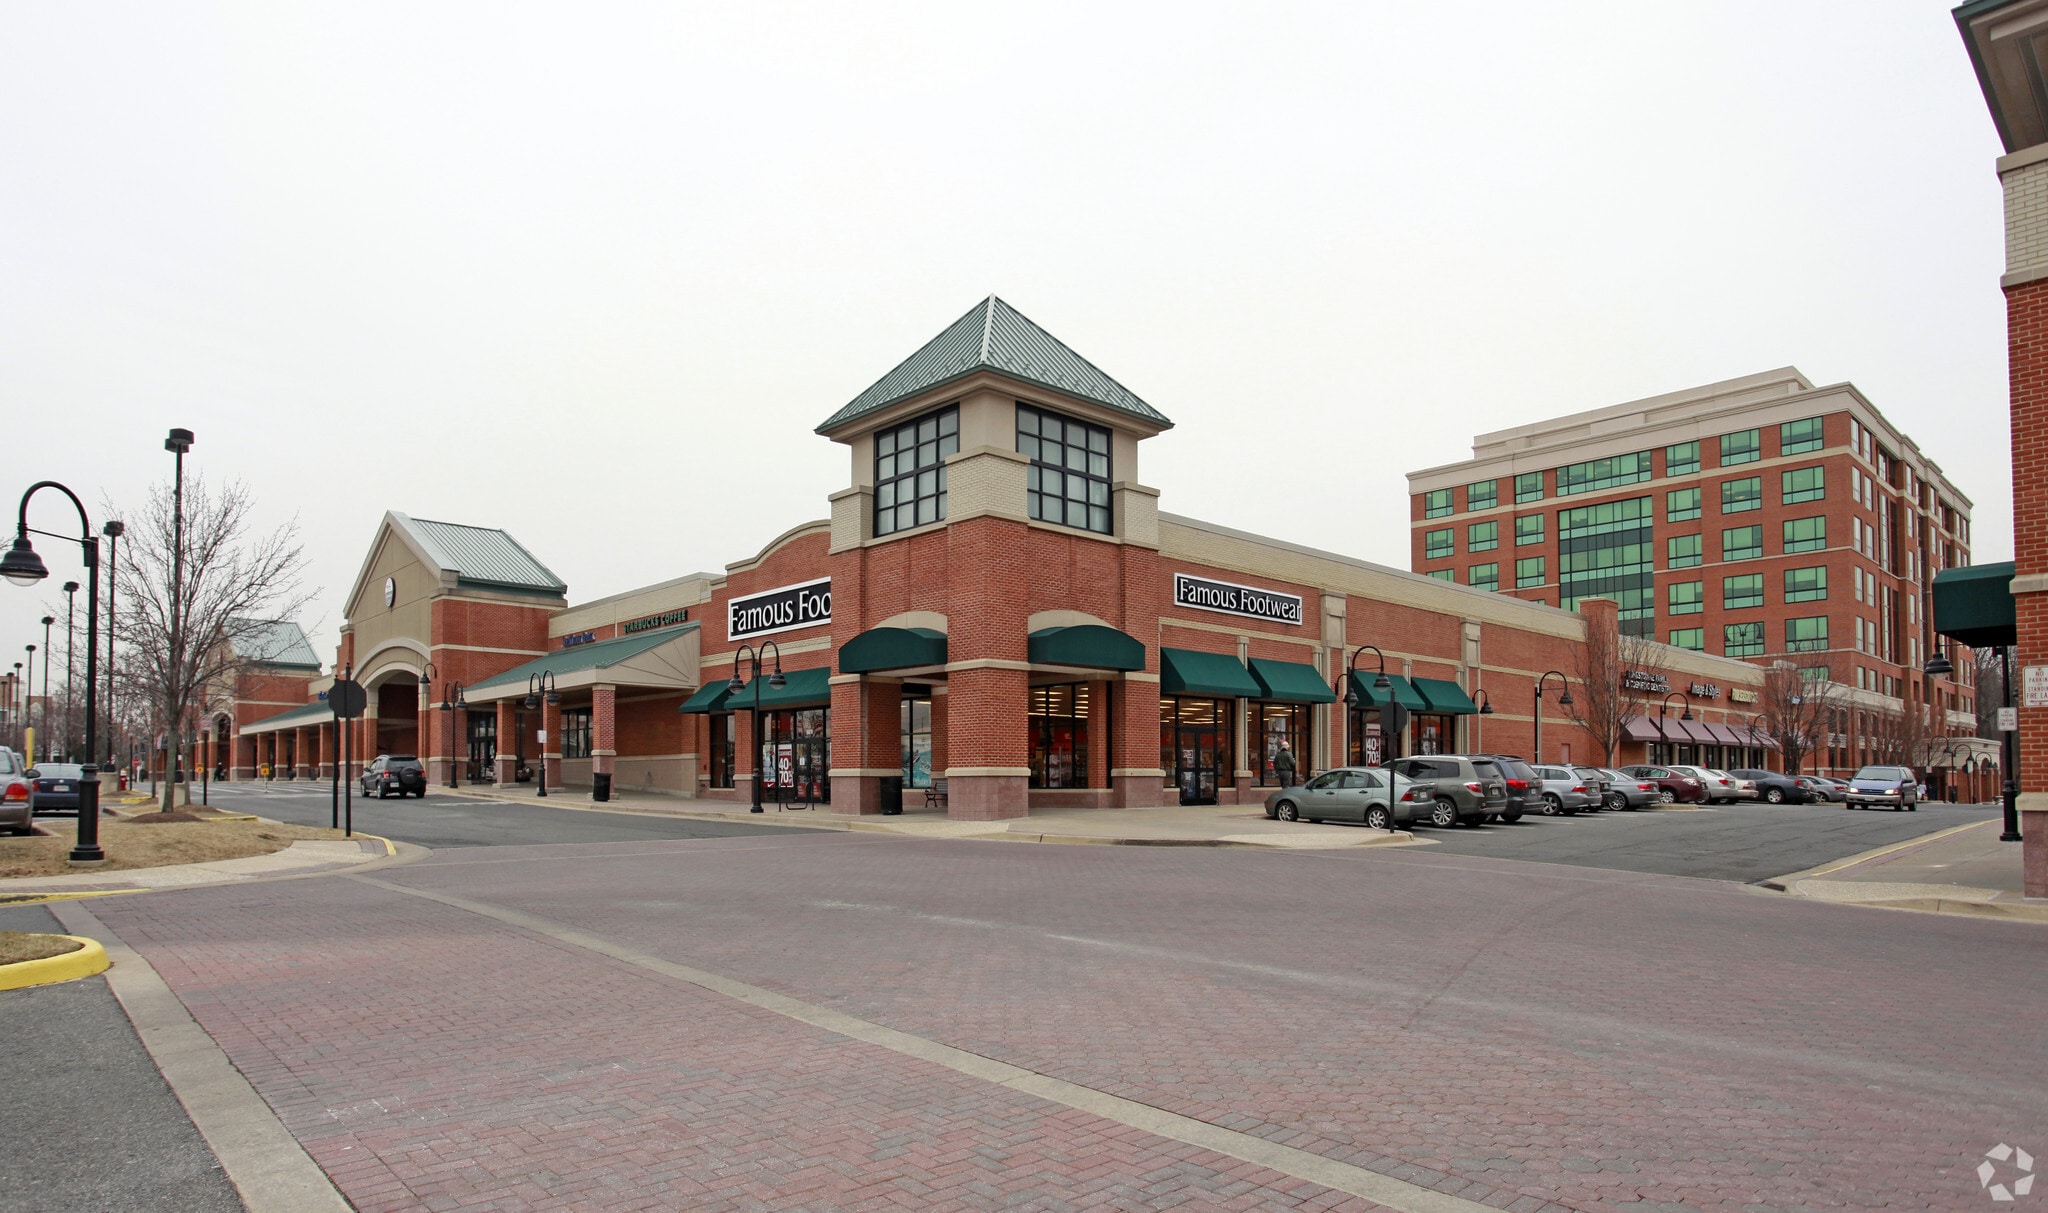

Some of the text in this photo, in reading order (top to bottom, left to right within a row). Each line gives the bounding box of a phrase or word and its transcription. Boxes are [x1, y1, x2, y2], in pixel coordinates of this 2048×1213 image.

[731, 590, 832, 633] Famous Foo
[1179, 578, 1302, 620] Famous Footwear
[623, 610, 688, 634] STARBUCKS COFFEE
